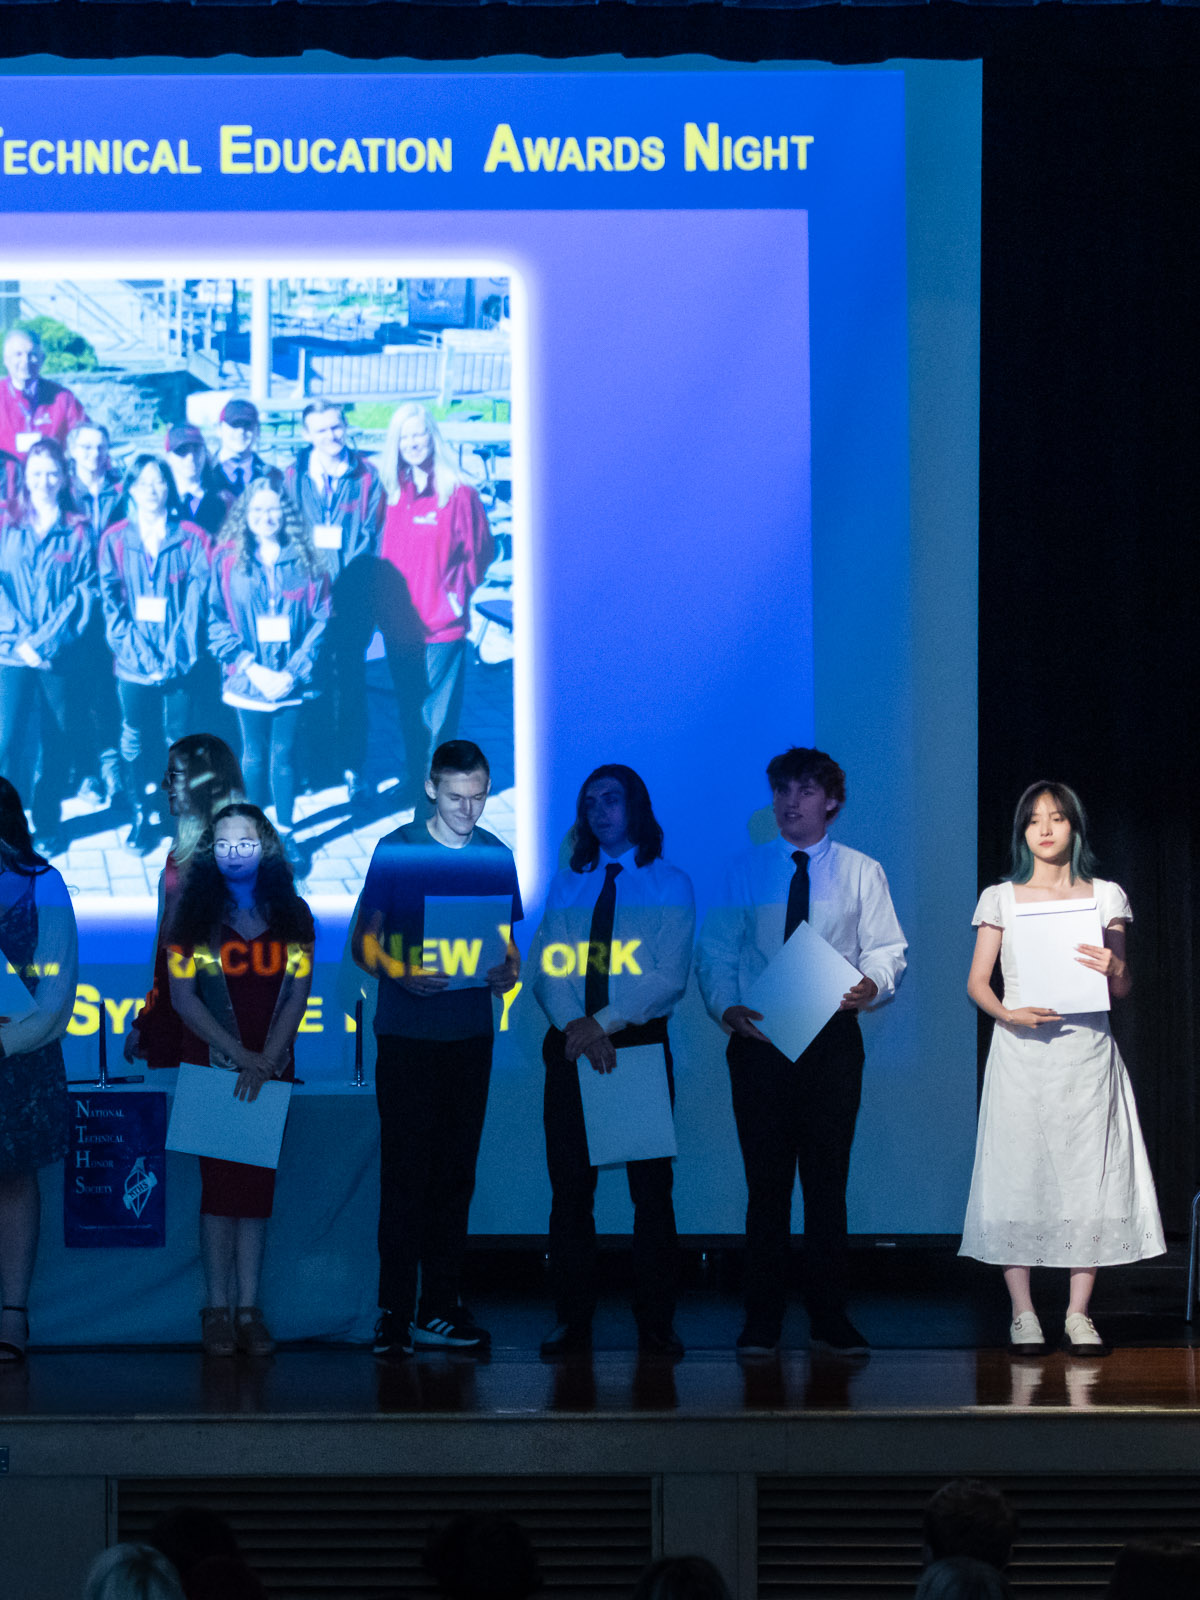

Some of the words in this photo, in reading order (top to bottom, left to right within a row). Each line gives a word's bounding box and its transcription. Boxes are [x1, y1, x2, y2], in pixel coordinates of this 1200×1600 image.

[220, 125, 452, 174] EDUCATION
[483, 123, 666, 172] AWARDS
[684, 122, 814, 171] NIGHT
